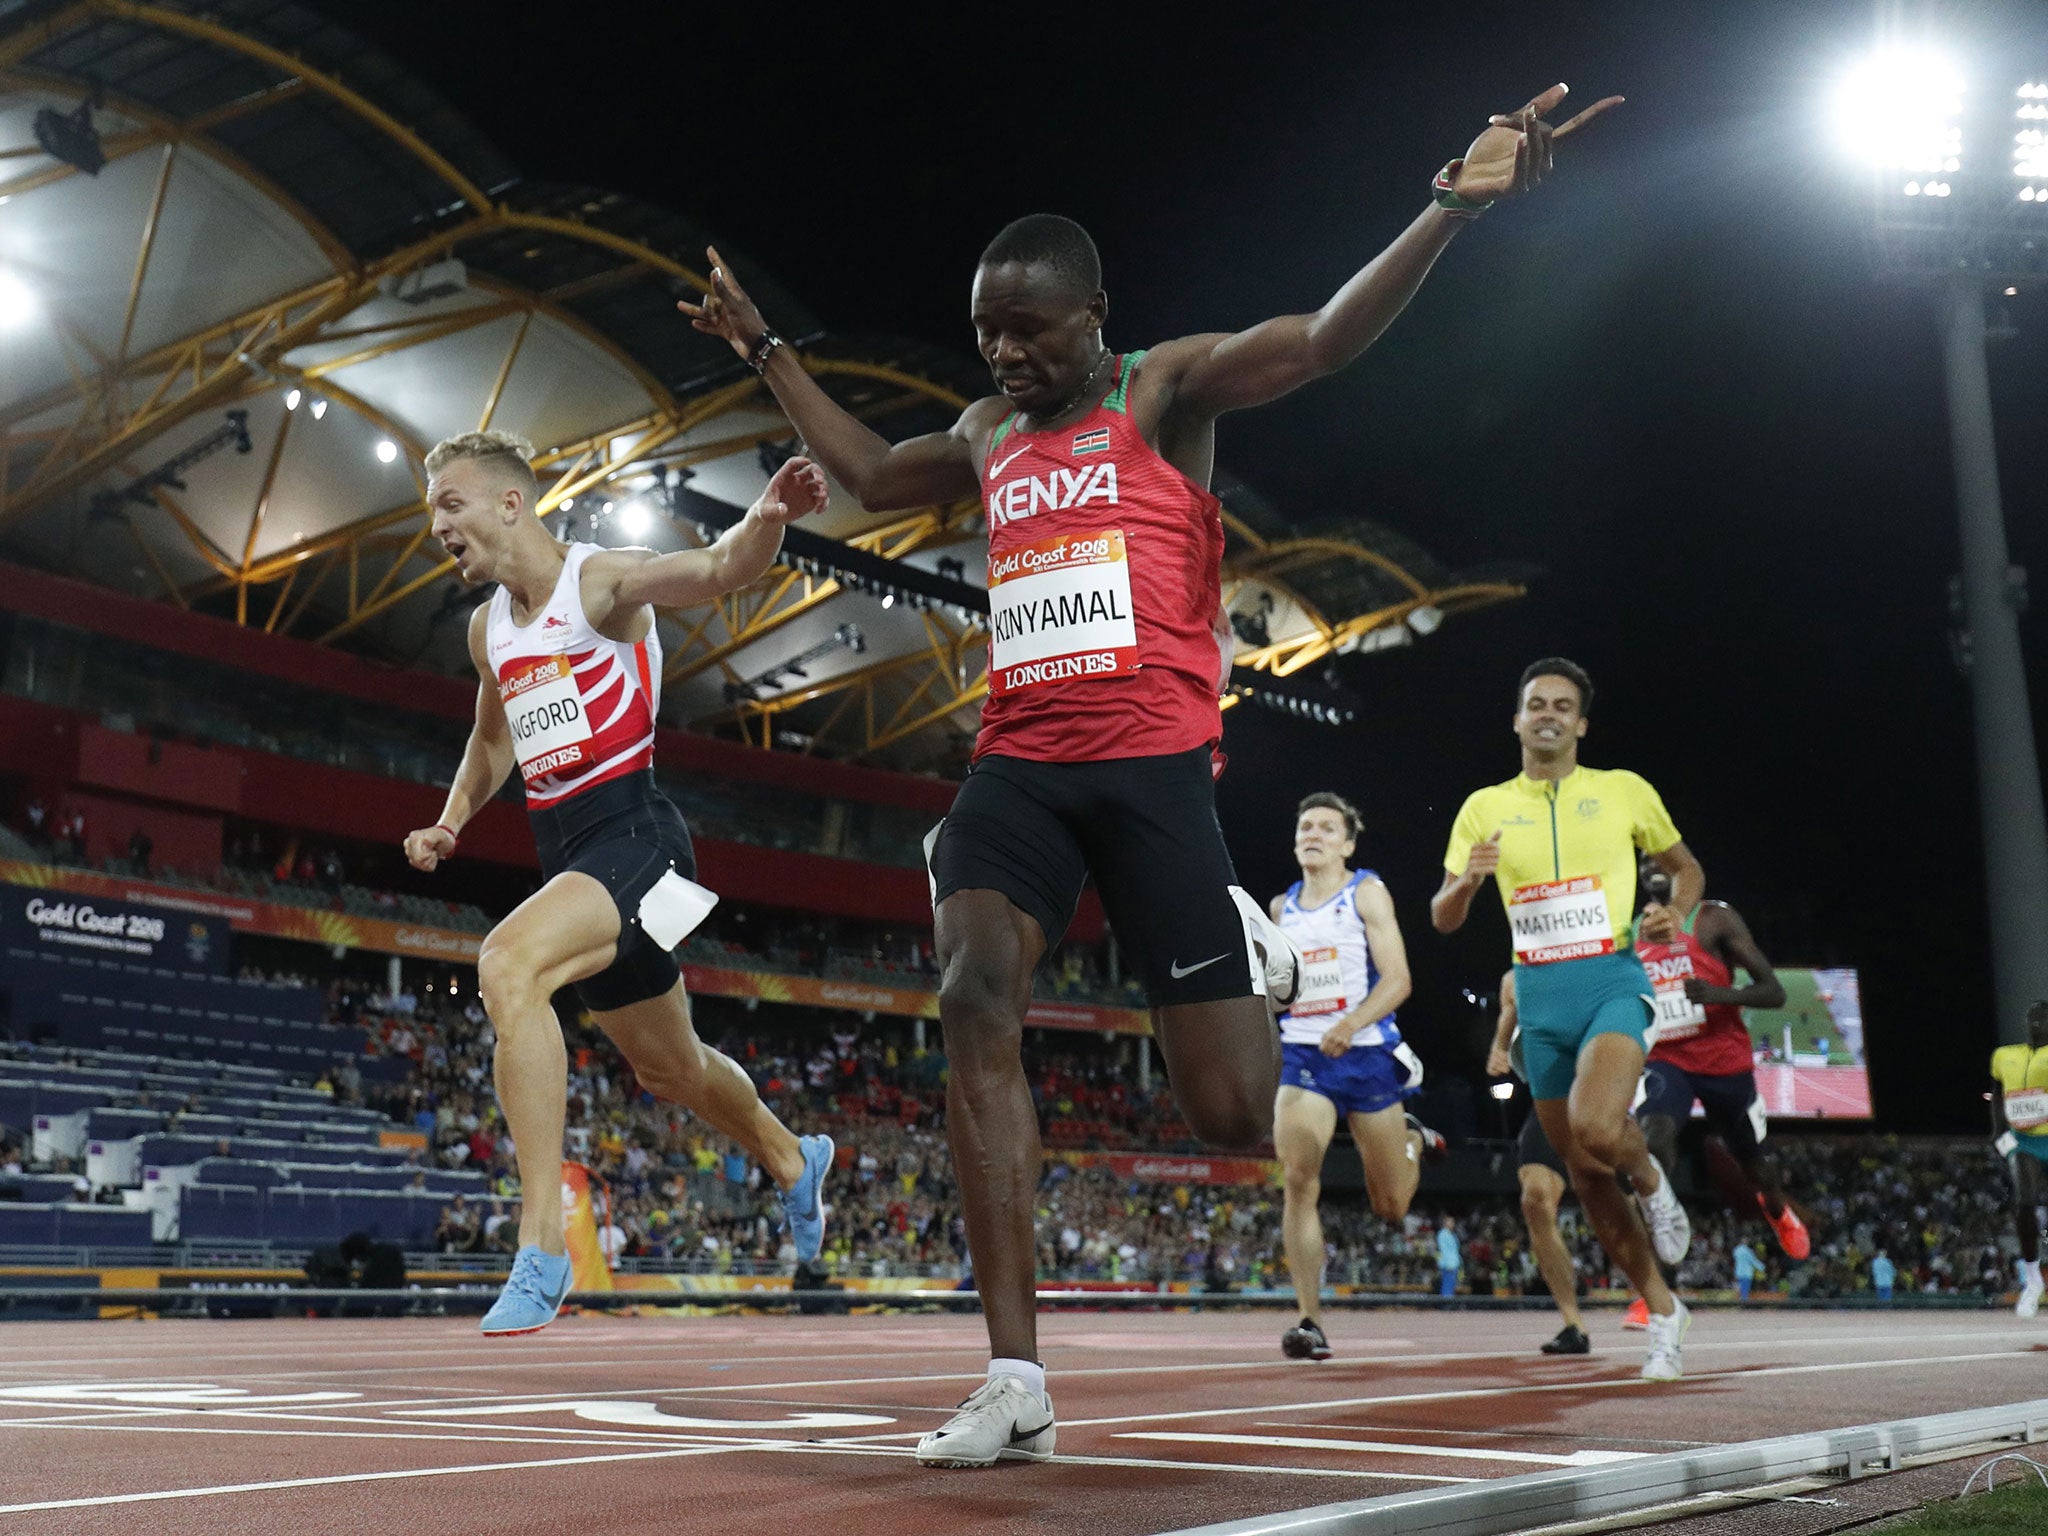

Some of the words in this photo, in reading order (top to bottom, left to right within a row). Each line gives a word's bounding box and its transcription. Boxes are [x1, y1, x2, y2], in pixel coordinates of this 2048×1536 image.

[989, 462, 1119, 531] KENYA
[992, 552, 1020, 578] Gold
[1022, 544, 1068, 568] Coast
[1070, 538, 1110, 560] 2018
[995, 589, 1126, 644] KINYAMAL
[509, 670, 535, 692] Coast
[535, 660, 560, 681] 2018
[1004, 652, 1118, 690] LONGINES
[512, 697, 579, 744] NGFORD
[521, 745, 583, 780] ONGINES
[26, 897, 76, 928] Gold
[75, 905, 126, 935] Coast
[125, 914, 165, 942] 2018
[1514, 905, 1606, 936] MATHEWS
[1304, 974, 1340, 990] TMAN
[1643, 955, 1695, 981] ENYA
